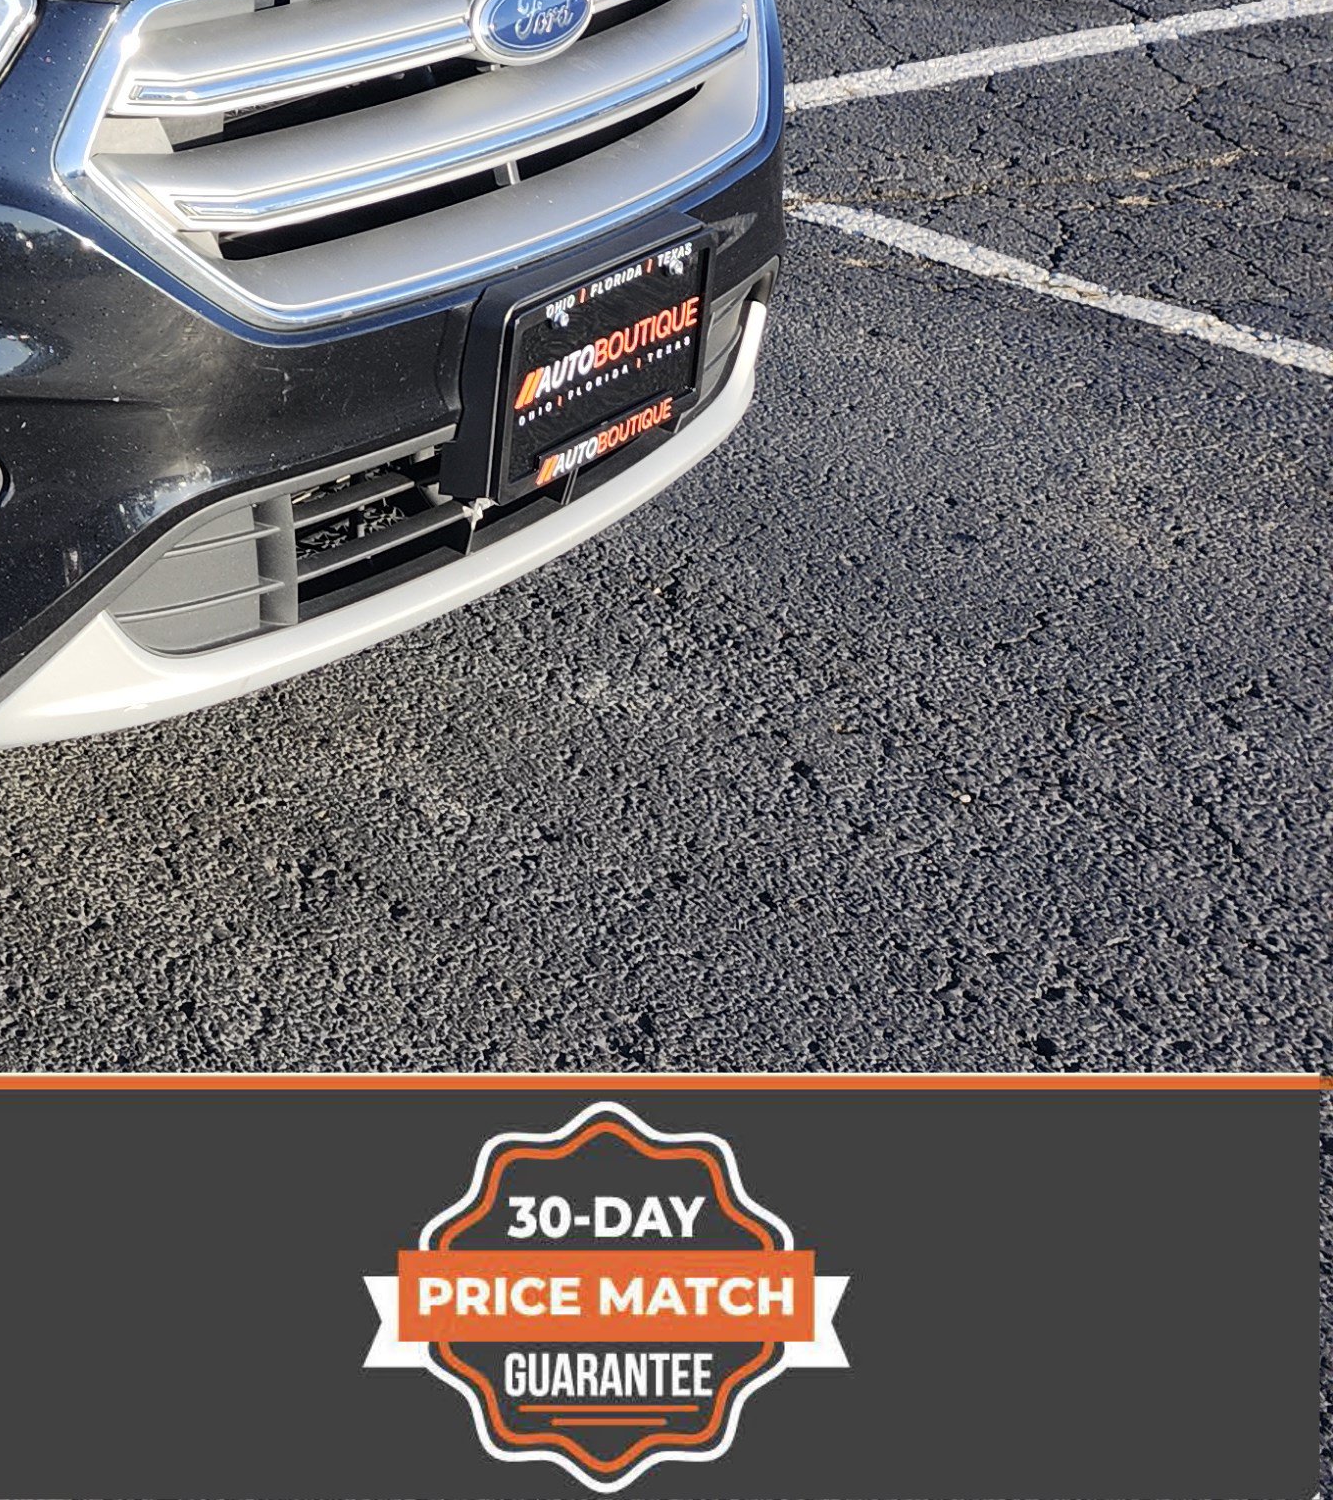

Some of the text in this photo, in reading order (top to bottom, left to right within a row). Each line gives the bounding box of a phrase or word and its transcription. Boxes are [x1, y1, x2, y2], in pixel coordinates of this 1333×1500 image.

[545, 241, 693, 319] OHIO FLORIDA TEXAS
[518, 400, 553, 427] OHIO
